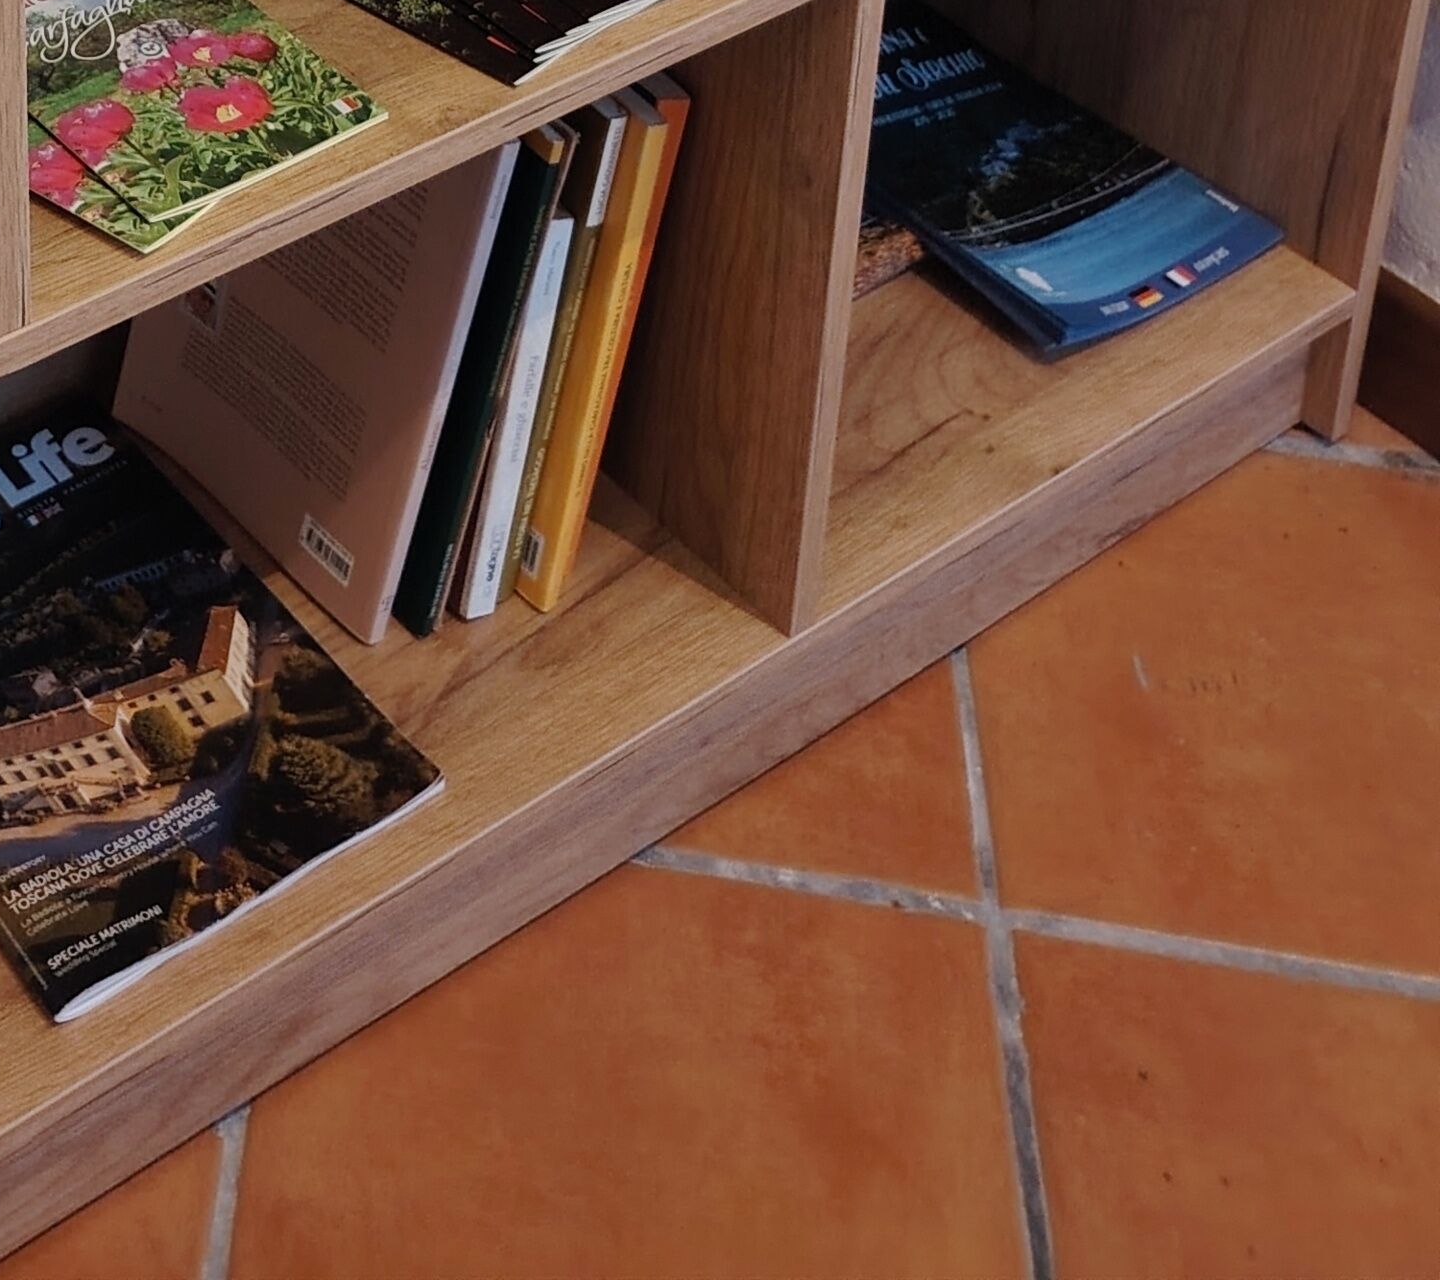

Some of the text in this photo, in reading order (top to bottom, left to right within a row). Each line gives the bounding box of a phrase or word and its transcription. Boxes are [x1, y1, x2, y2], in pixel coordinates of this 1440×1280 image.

[2, 889, 21, 906] LA
[77, 851, 104, 868] UNA
[103, 835, 133, 857] CASA
[134, 827, 150, 841] DI
[148, 788, 216, 833] CAMPAGNA
[10, 799, 221, 916] TOSCANA DOVE CELEBRARE L'AMORE
[47, 904, 164, 971] SPECIALE MATRIMONI
